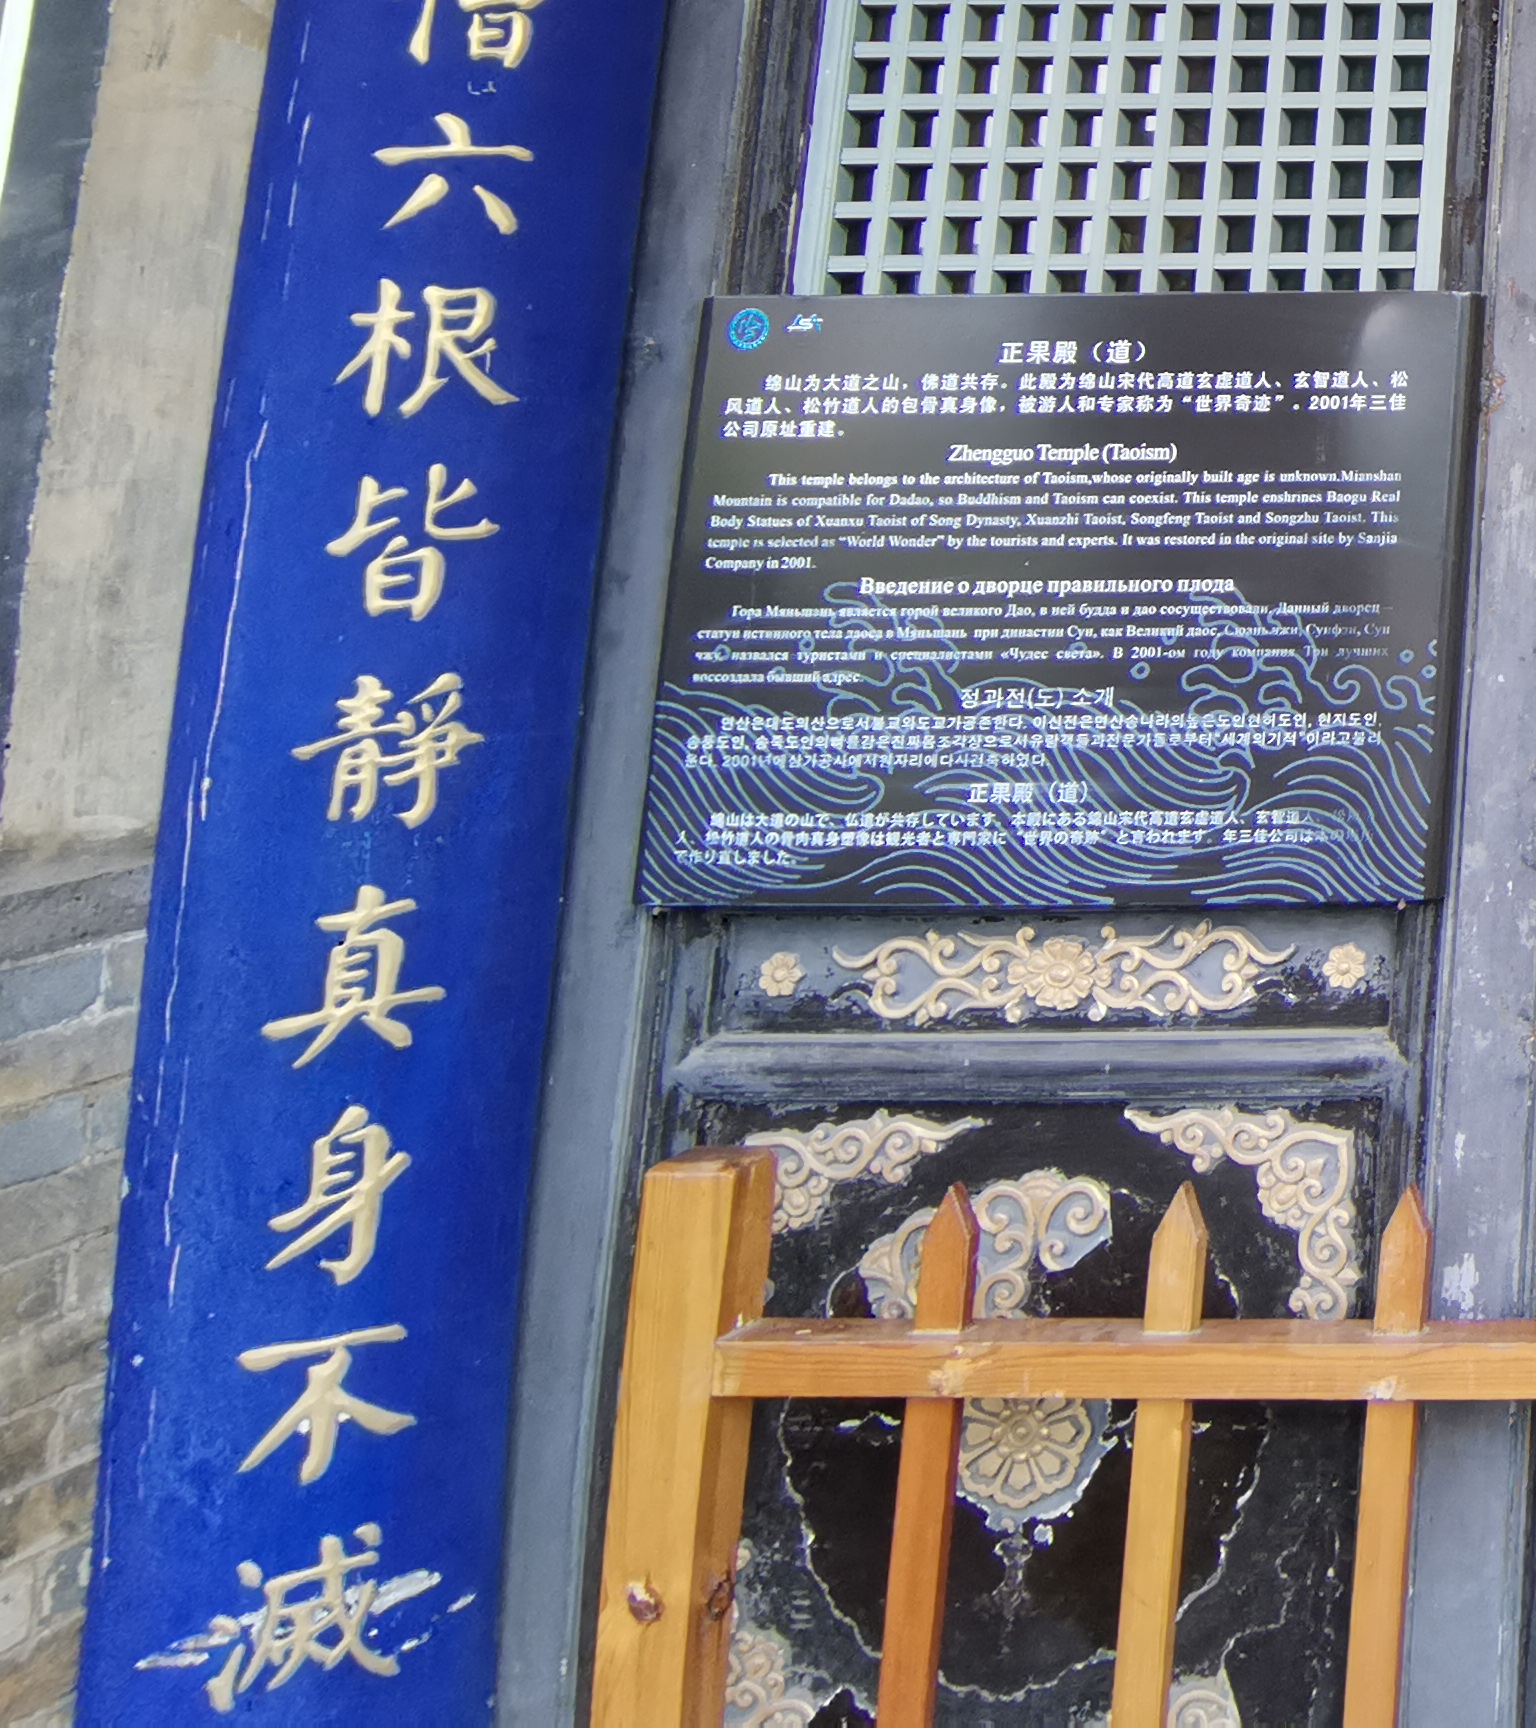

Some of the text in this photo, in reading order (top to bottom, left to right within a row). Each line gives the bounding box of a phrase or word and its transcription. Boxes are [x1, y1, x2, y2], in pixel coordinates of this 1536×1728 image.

[948, 442, 1177, 466] Zhengguo Temple (Taoism)
[769, 473, 797, 486] This
[801, 473, 844, 488] temple
[848, 473, 898, 488] belongs
[902, 474, 916, 485] to
[919, 472, 940, 485] the
[943, 472, 1020, 484] architecture
[1023, 472, 1040, 484] of
[1135, 471, 1199, 486] originally
[1202, 471, 1233, 483] built
[1236, 473, 1260, 485] age
[1263, 470, 1275, 483] is
[713, 493, 772, 506] Mountain
[776, 493, 787, 505] is
[791, 493, 862, 508] compatible
[866, 493, 885, 505] for
[938, 495, 953, 505] so
[957, 492, 1021, 504] Buddhism
[1024, 492, 1049, 504] and
[1052, 492, 1098, 504] Taoism
[1102, 495, 1125, 504] can
[1182, 491, 1212, 504] This
[1215, 491, 1258, 506] temple
[1262, 491, 1322, 503] enshrines
[1326, 491, 1367, 506] Baogu
[1371, 491, 1400, 503] Real
[710, 514, 743, 529] Body
[746, 514, 793, 526] Statues
[796, 514, 811, 526] of
[814, 514, 864, 526] Xuanxu
[869, 514, 907, 526] Taoist
[910, 514, 927, 526] of
[928, 513, 962, 528] Song
[1026, 513, 1078, 525] Xuanzhi
[1130, 513, 1191, 528] Songfeng
[1195, 512, 1234, 525] Taoist
[1237, 512, 1261, 524] and
[1264, 512, 1319, 527] Songzhu
[1371, 512, 1399, 524] This
[707, 535, 750, 550] temple
[753, 535, 764, 547] is
[767, 535, 818, 547] selected
[821, 538, 835, 547] as
[946, 534, 964, 549] by
[966, 534, 987, 547] the
[990, 534, 1038, 546] tourists
[1040, 534, 1065, 546] and
[1122, 534, 1133, 546] It
[1136, 537, 1161, 546] was
[1164, 533, 1216, 546] restored
[1218, 533, 1232, 545] in
[1235, 533, 1255, 545] the
[1258, 533, 1308, 548] original
[1312, 533, 1334, 545] site
[1338, 533, 1354, 548] by
[1358, 533, 1397, 548] Sanjia
[704, 556, 764, 571] Company
[766, 556, 779, 568] in
[1070, 686, 1115, 706] 소개
